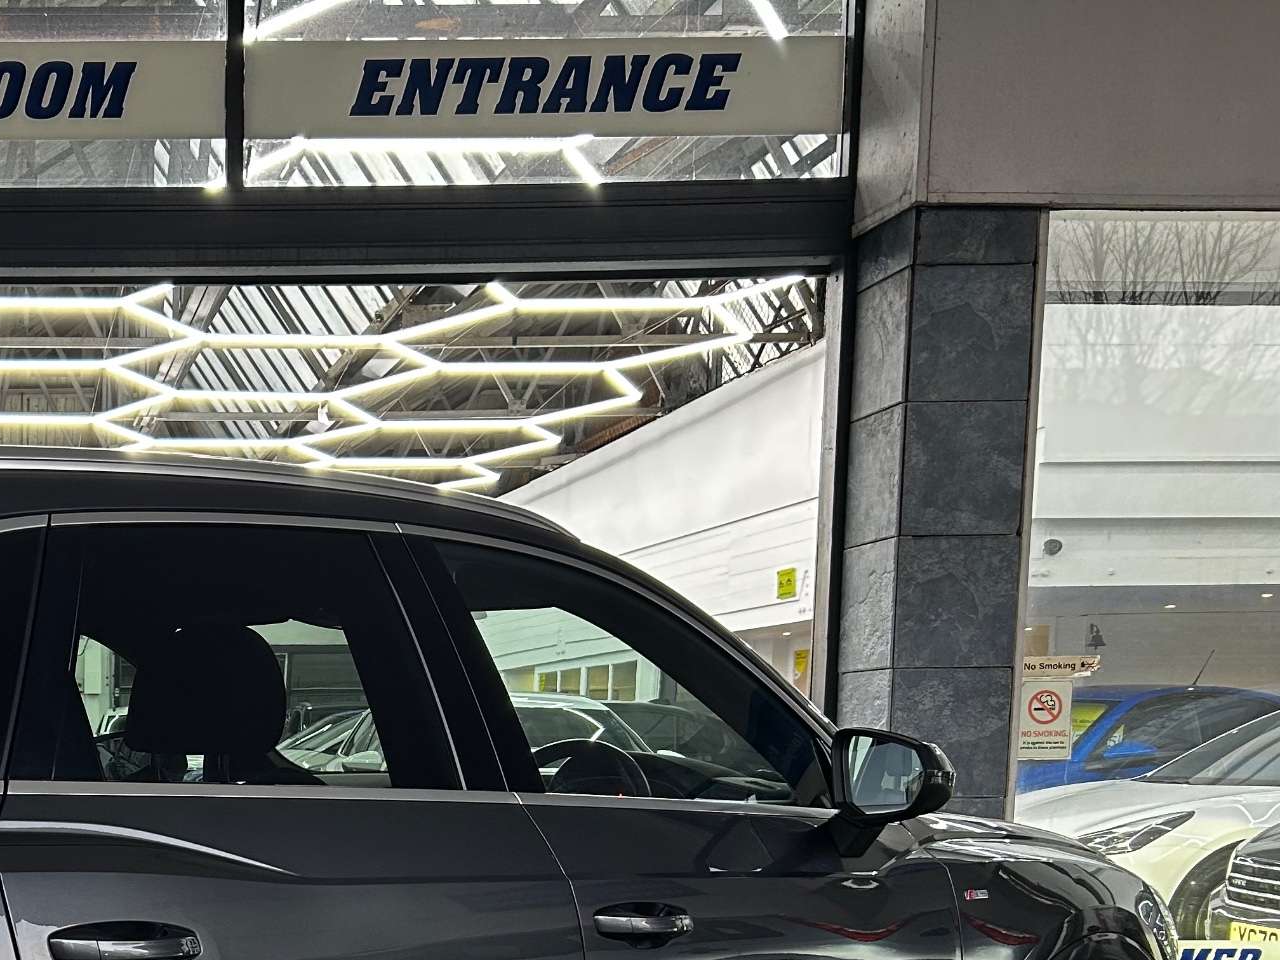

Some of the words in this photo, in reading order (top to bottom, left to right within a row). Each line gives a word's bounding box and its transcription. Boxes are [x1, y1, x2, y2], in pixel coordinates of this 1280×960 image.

[349, 52, 742, 116] ENTRANCE
[1023, 662, 1037, 671] No
[1039, 661, 1076, 671] Smoking
